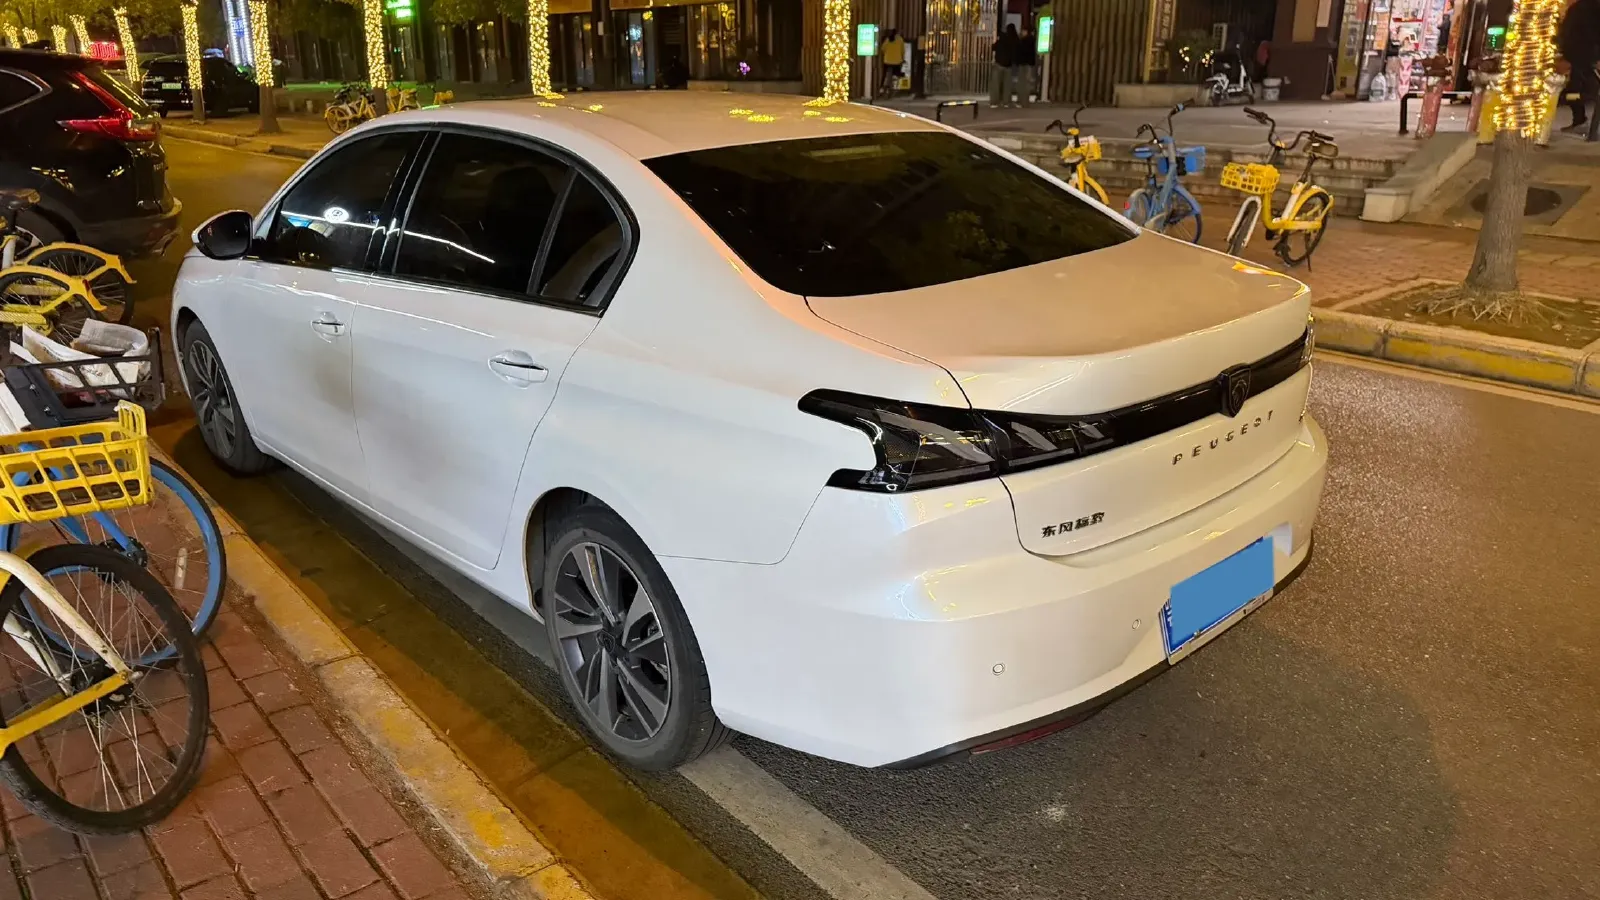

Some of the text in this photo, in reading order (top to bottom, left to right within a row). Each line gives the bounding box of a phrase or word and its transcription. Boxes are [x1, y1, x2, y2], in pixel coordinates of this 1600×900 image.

[1172, 410, 1273, 465] PEUGEOT
[1042, 512, 1104, 538] 东风标致
